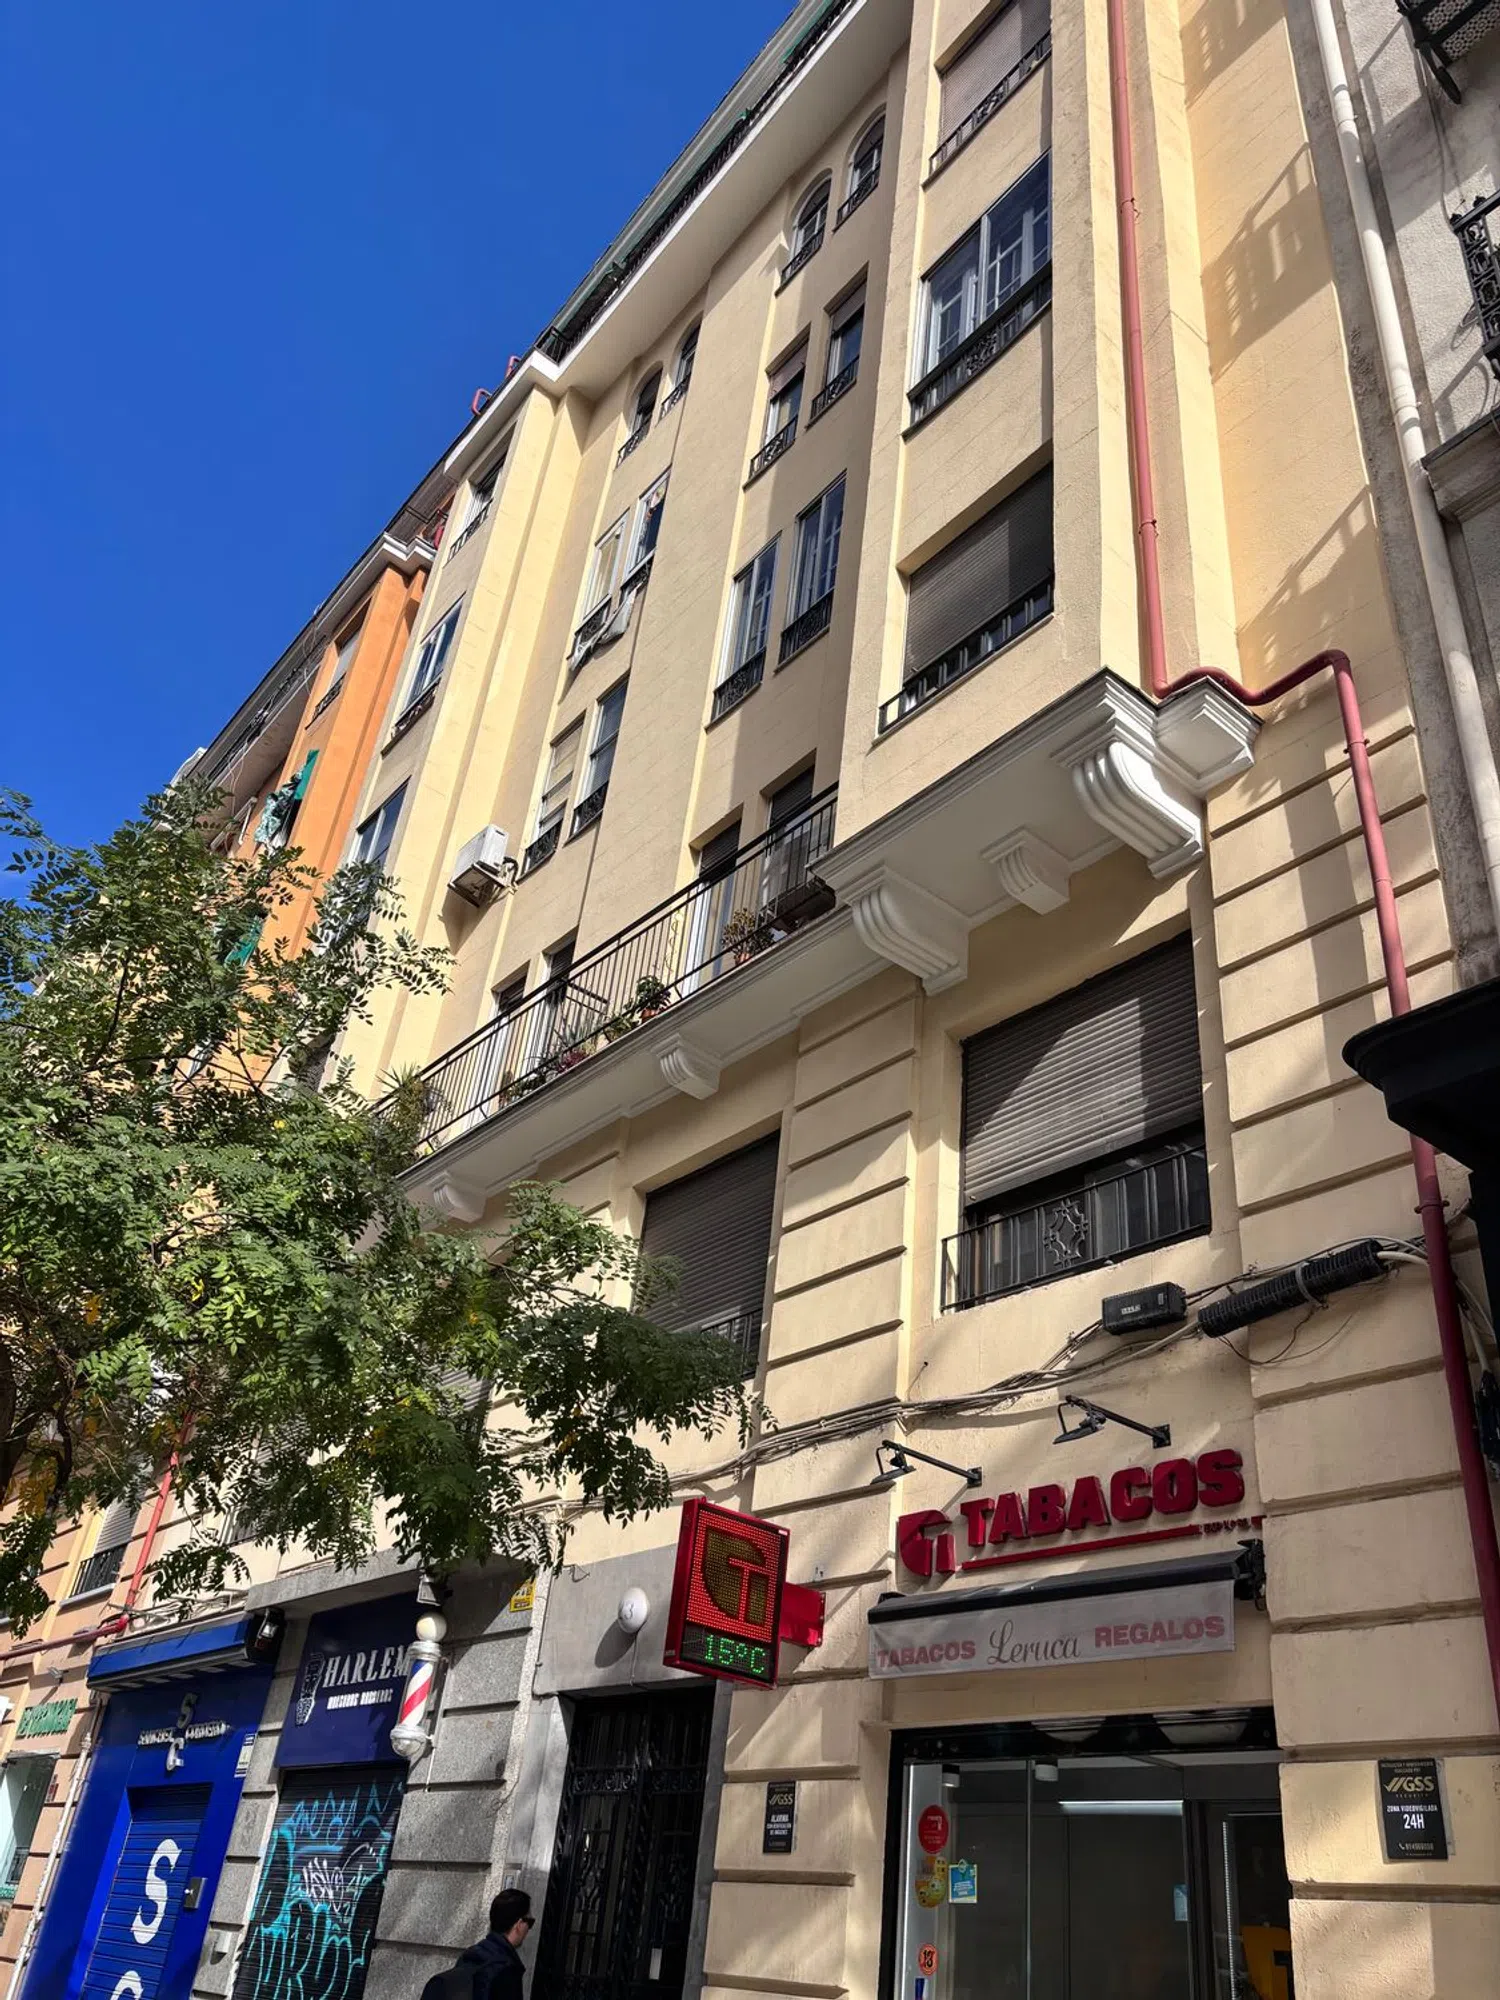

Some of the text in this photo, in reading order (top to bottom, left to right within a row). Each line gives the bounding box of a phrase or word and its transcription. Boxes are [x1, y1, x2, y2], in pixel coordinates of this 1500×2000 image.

[961, 1449, 1245, 1547] TABACOS
[322, 1645, 410, 1688] HARLEM
[876, 1616, 1225, 1668] TABACOS Leruca REGALOS
[1403, 1813, 1425, 1829] 24H
[130, 1838, 182, 1944] S
